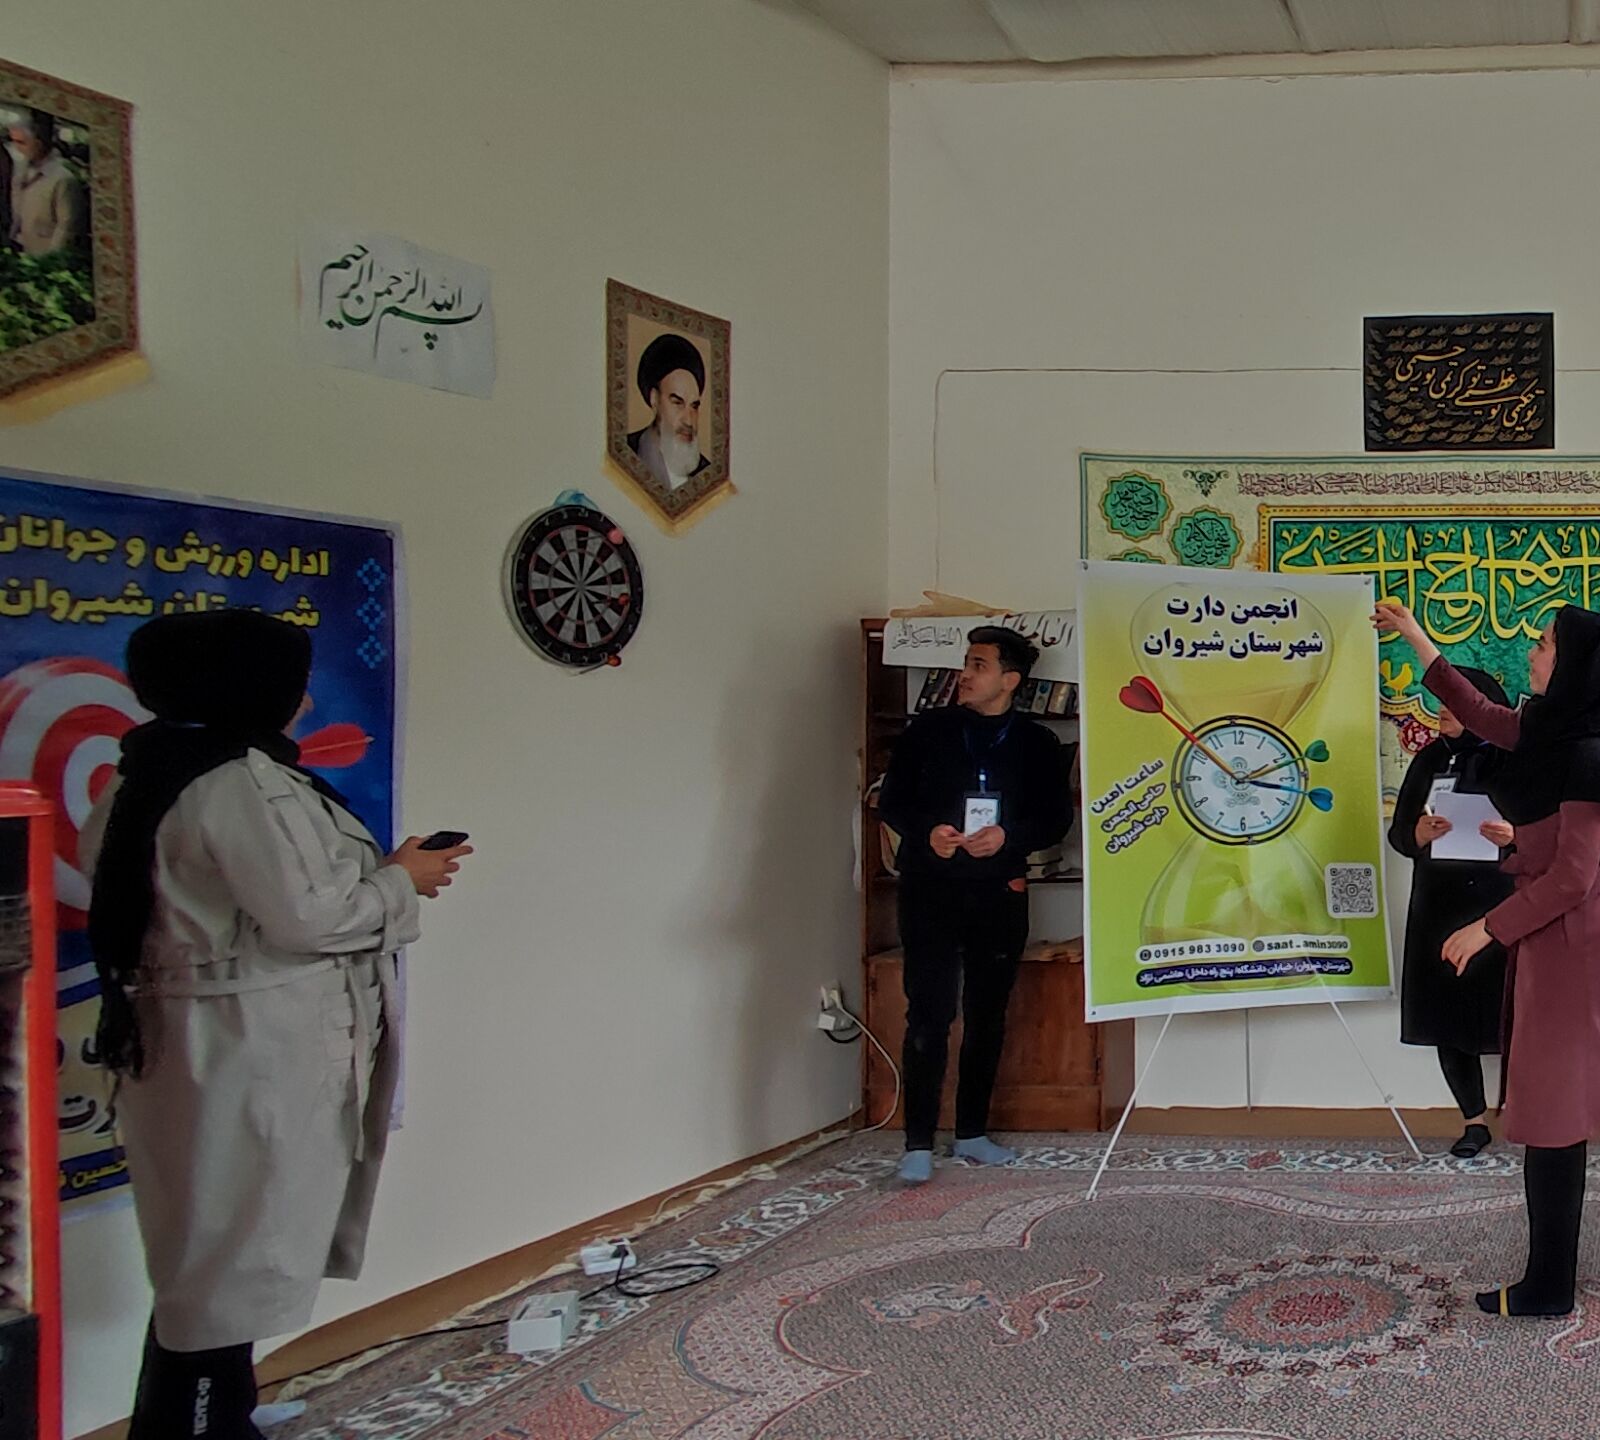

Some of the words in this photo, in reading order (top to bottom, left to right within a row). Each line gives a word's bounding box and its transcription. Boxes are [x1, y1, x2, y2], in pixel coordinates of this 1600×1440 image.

[125, 537, 146, 568] و
[155, 531, 252, 578] ورزش
[259, 547, 329, 583] اداره
[0, 578, 153, 623] شیروان
[1167, 596, 1224, 624] دارت
[1231, 597, 1297, 625] انجمن
[1144, 629, 1224, 659] شیروان
[1229, 631, 1323, 659] شهرستان
[1208, 734, 1223, 750] 11
[1233, 730, 1245, 745] 12
[1257, 736, 1266, 749] 1
[1273, 753, 1286, 763] 2
[1124, 760, 1164, 789] ساعت
[1279, 775, 1295, 783] 3
[1091, 783, 1124, 813] امین
[1136, 784, 1166, 811] حامی
[1194, 796, 1208, 808] 8
[1276, 797, 1290, 807] 4
[1102, 801, 1138, 832] انجمن
[1144, 807, 1168, 826] دارت
[1215, 811, 1224, 826] 7
[1240, 816, 1246, 831] 6
[1260, 811, 1271, 825] 5
[1106, 821, 1146, 853] شیروان
[1154, 943, 1185, 958] 0915
[1189, 943, 1211, 955] 983
[1216, 942, 1245, 953] 3090
